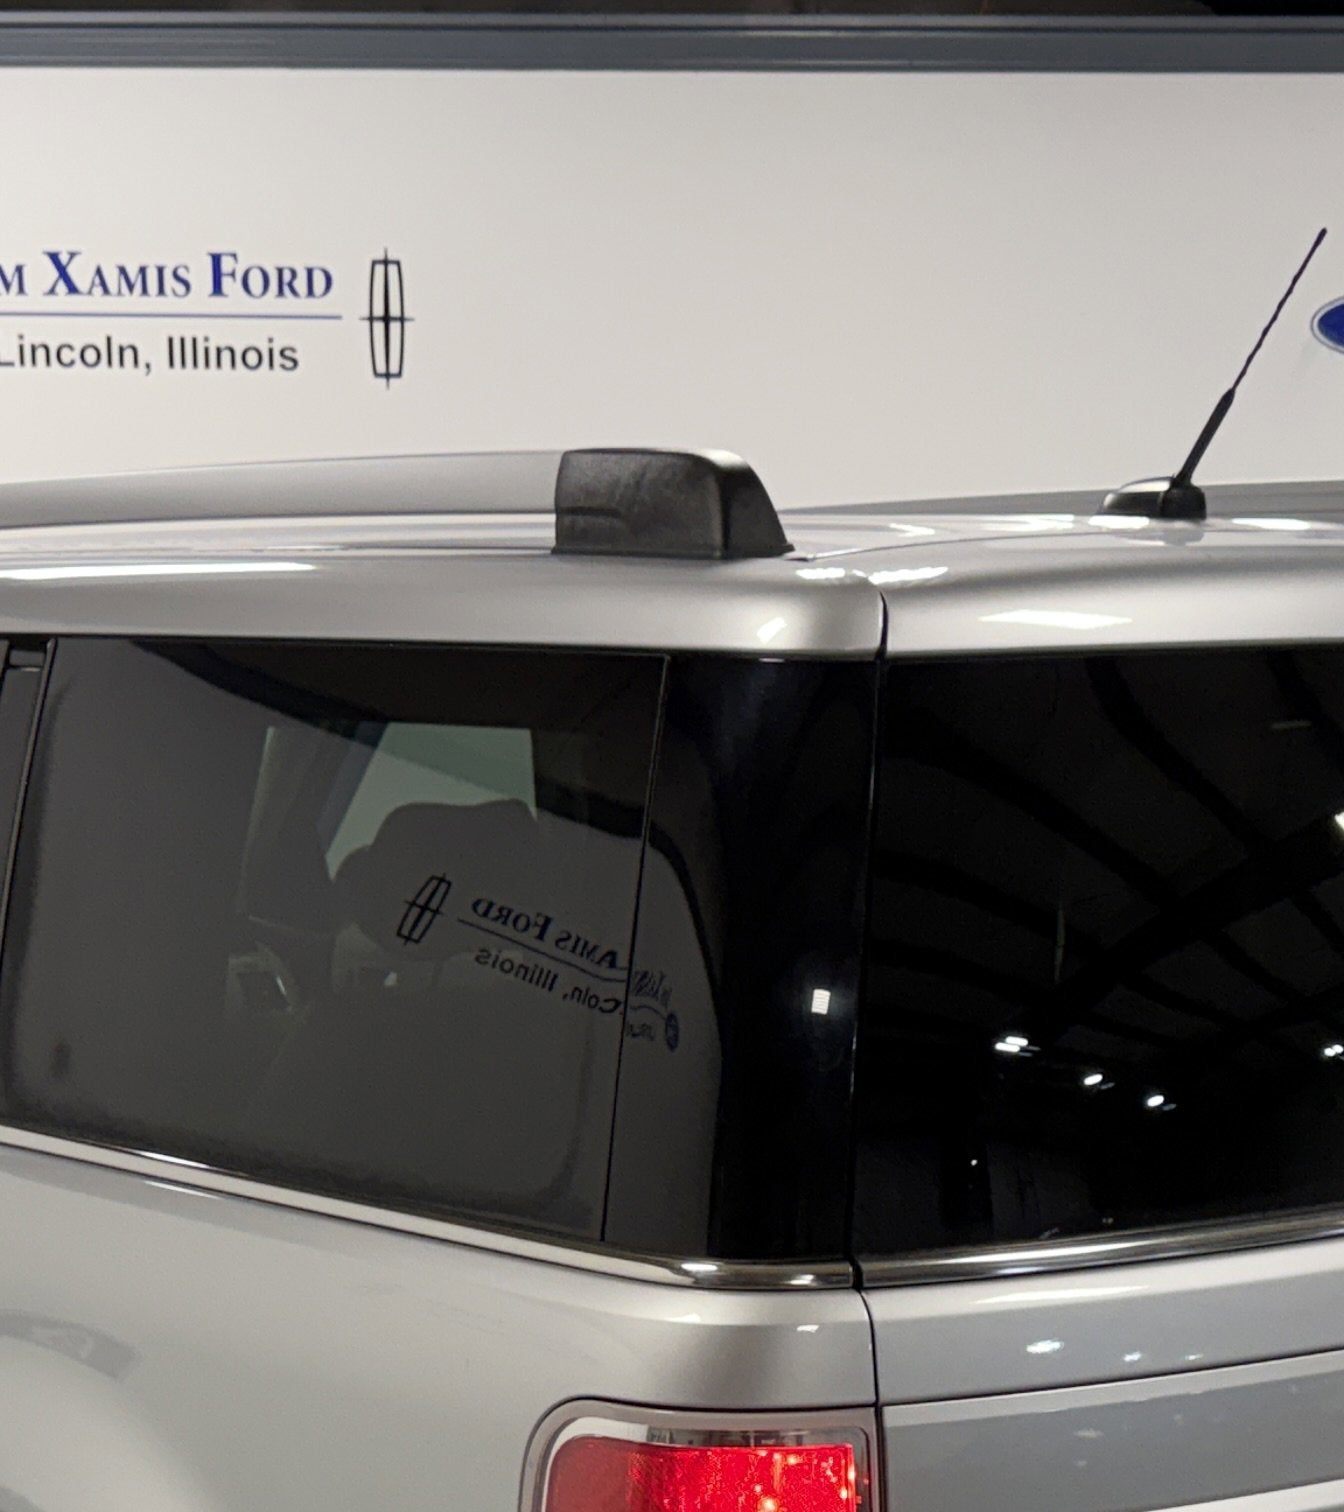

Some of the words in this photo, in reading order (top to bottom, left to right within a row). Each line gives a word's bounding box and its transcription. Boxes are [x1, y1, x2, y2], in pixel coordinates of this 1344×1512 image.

[43, 251, 192, 298] XAMIS
[207, 252, 334, 299] FORD
[166, 335, 300, 373] Illinois
